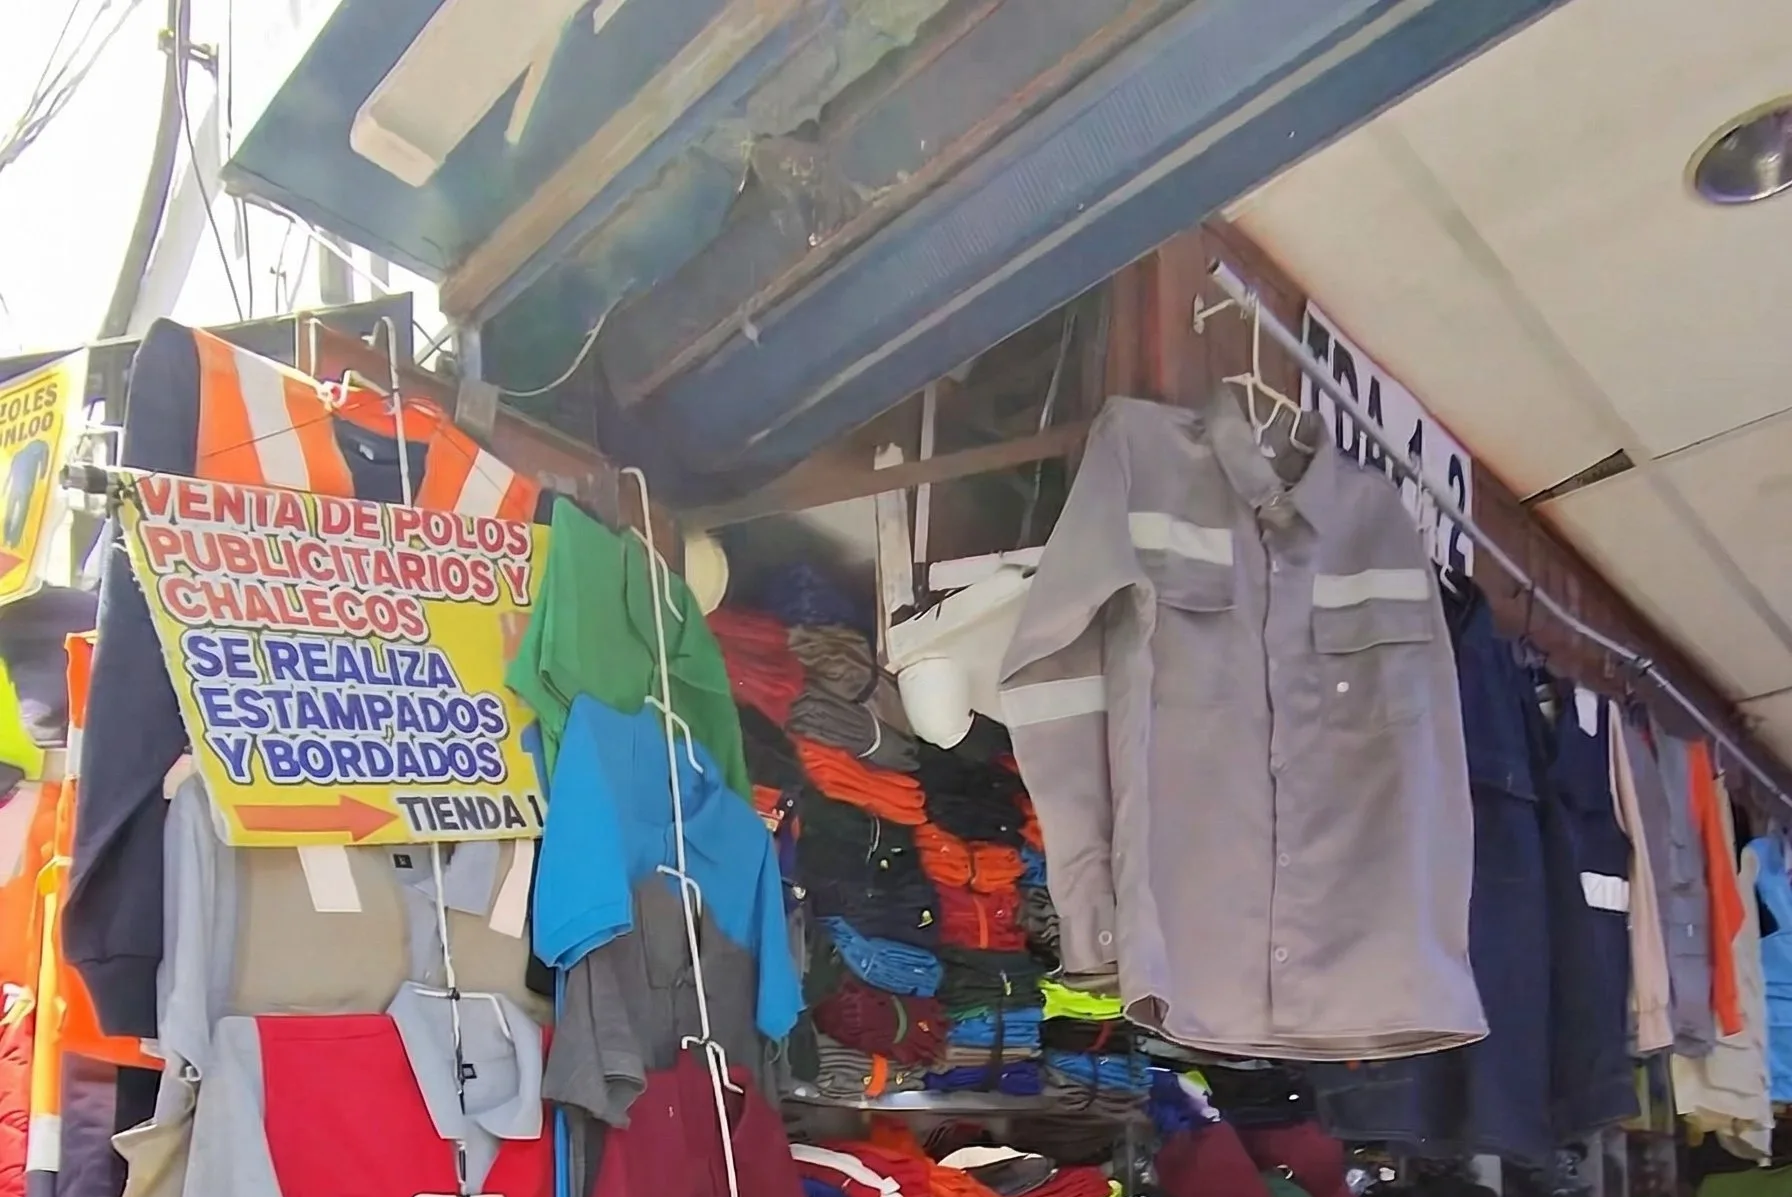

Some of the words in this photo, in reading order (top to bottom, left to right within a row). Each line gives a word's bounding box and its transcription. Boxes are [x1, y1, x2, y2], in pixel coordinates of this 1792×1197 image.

[139, 476, 305, 529] VENTA
[320, 500, 382, 540] DE
[394, 507, 530, 556] POLOS
[143, 526, 496, 599] PUBLICITARIOS
[502, 564, 529, 601] Y
[164, 576, 425, 637] CHALECOS
[186, 635, 257, 680] SE
[263, 639, 457, 690] REALIZA
[199, 686, 505, 735] ESTAMPADOS
[211, 736, 251, 778] Y
[261, 737, 503, 779] BORDADOS
[396, 795, 527, 832] TIENDA
